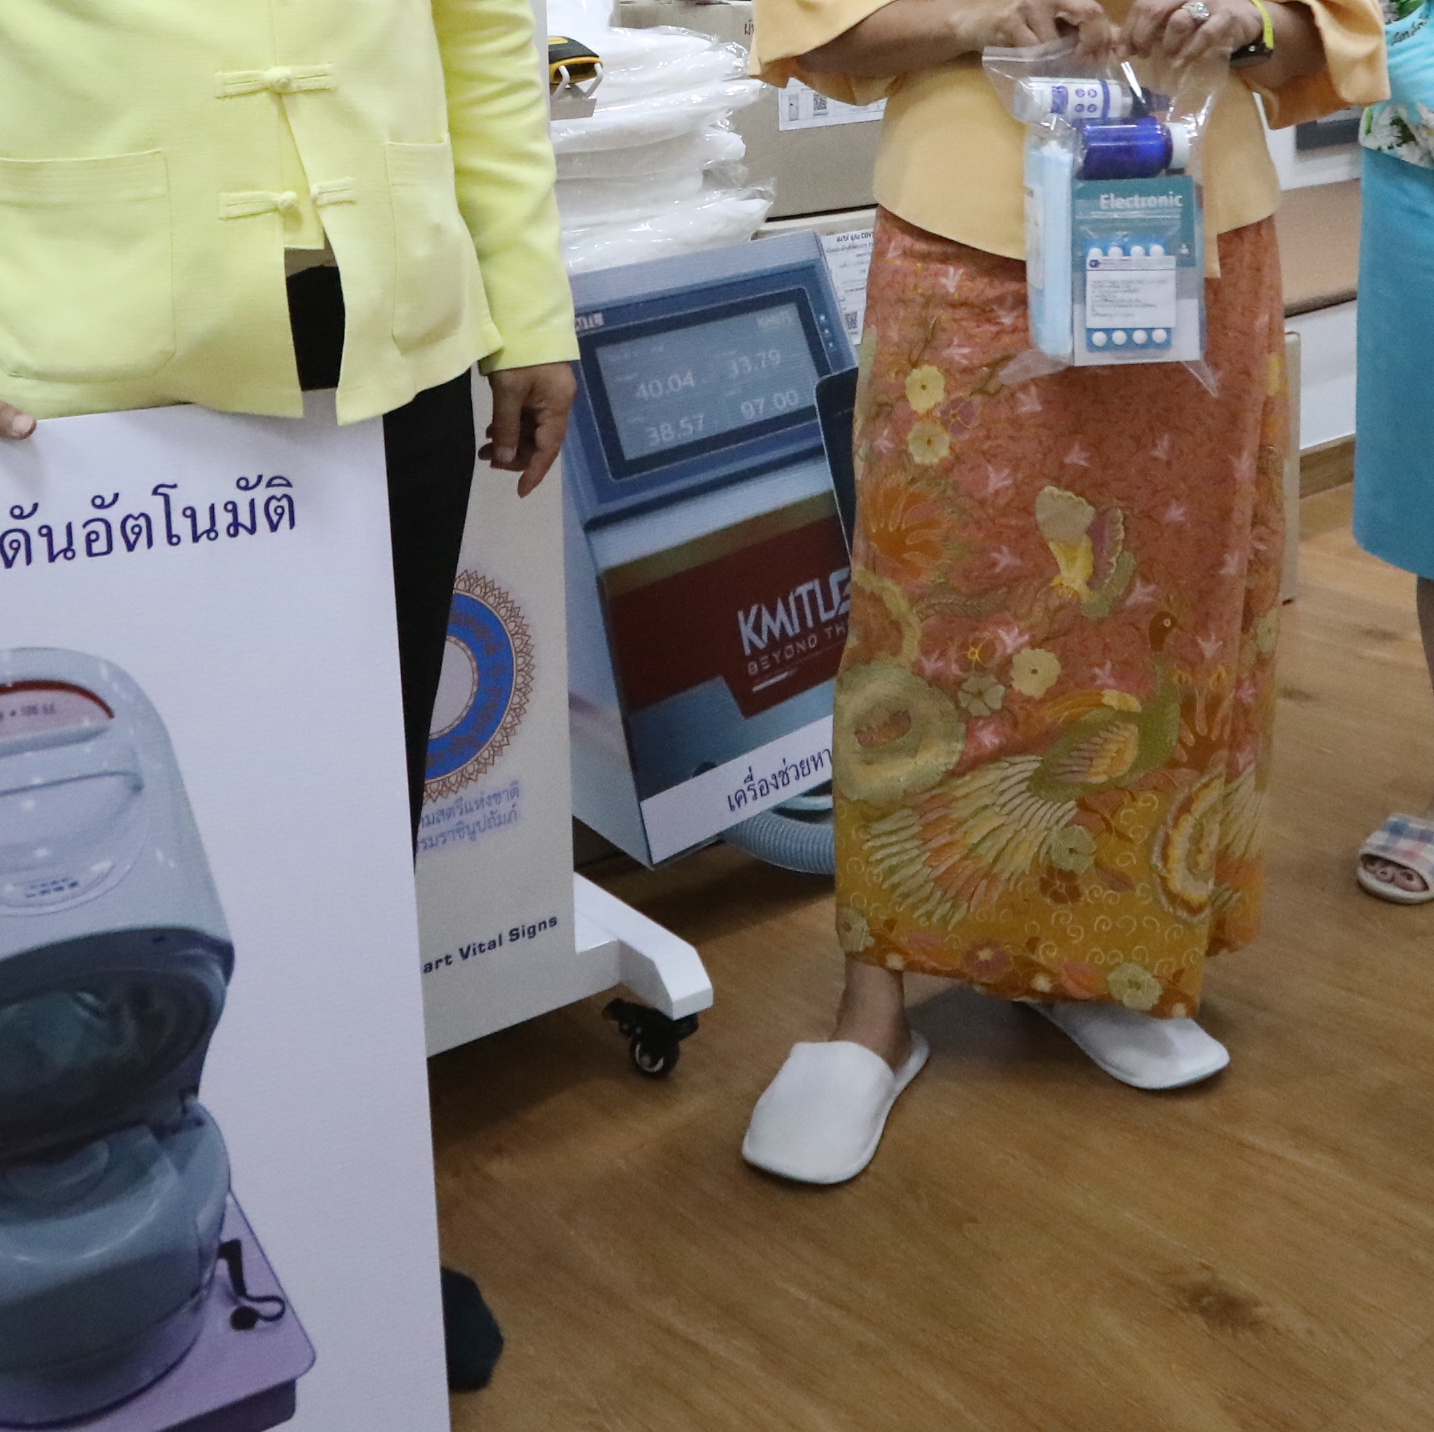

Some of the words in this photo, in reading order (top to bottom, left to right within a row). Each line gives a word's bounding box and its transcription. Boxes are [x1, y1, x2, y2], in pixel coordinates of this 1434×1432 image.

[1099, 190, 1183, 210] Electronic
[458, 933, 503, 960] Vital
[508, 915, 558, 943] Signs
